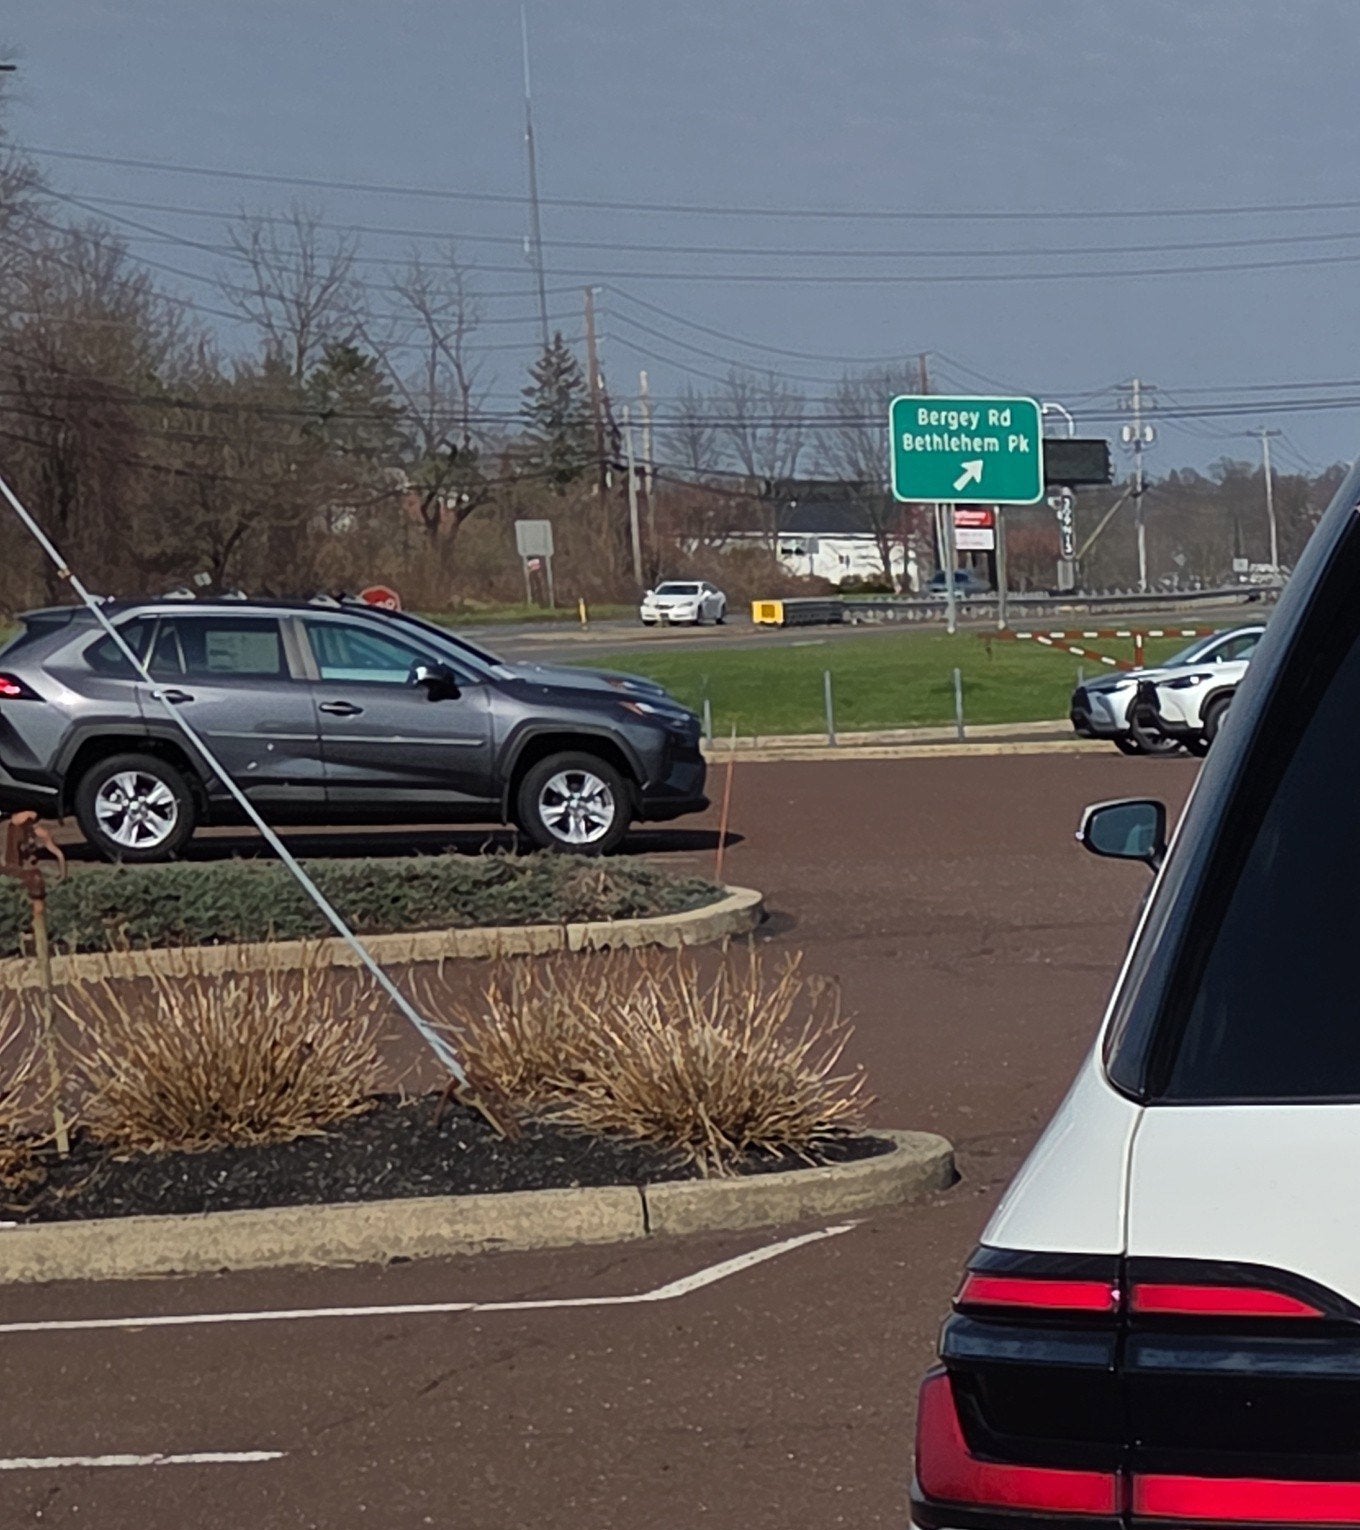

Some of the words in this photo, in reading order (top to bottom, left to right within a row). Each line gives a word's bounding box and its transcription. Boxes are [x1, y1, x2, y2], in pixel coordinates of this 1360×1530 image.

[917, 408, 980, 430] Bergey
[988, 408, 1011, 428] Rd
[902, 433, 1000, 452] Bethlehem
[1008, 434, 1030, 453] Pk
